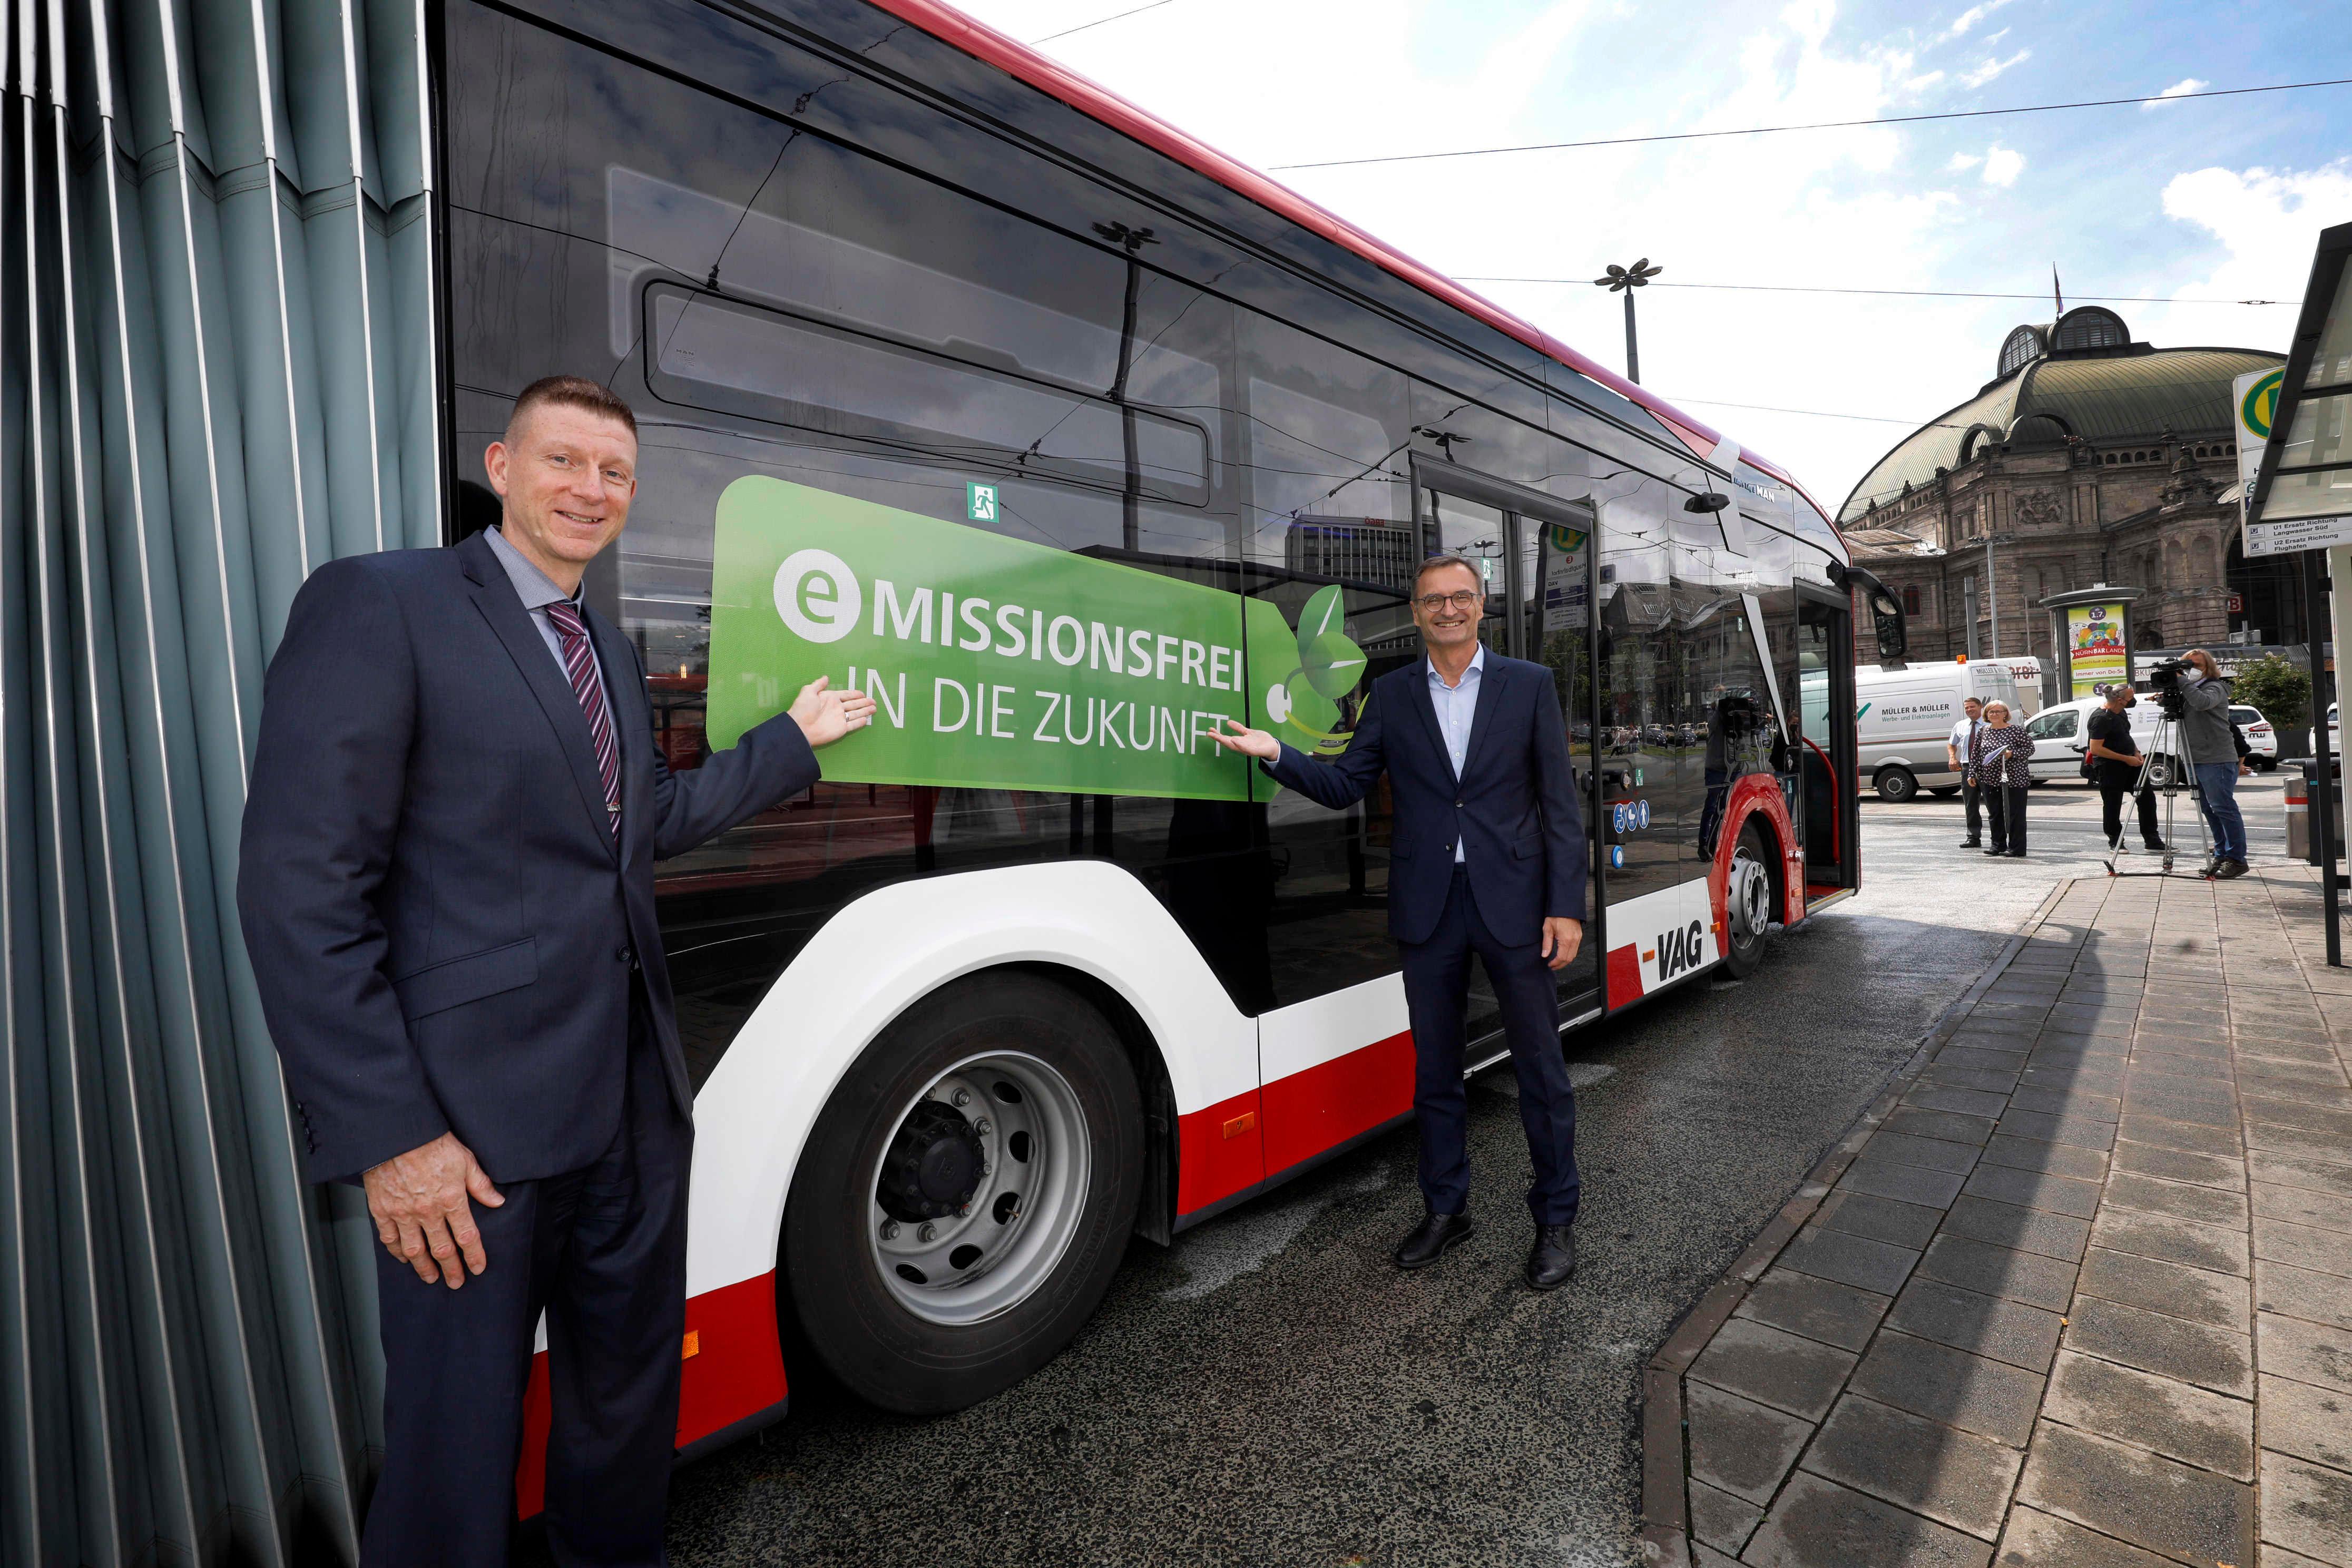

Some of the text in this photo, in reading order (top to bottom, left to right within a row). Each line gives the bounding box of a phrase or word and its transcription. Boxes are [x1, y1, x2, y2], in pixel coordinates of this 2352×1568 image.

[1756, 484, 1775, 503] MAN
[2273, 527, 2313, 536] Langwasser
[933, 677, 1015, 739] DIE
[1033, 690, 1229, 757] ZUKUNFT
[1882, 707, 1910, 716] MÜLLER
[1919, 703, 1949, 712] MÜLLER
[1658, 919, 1702, 983] VAG
